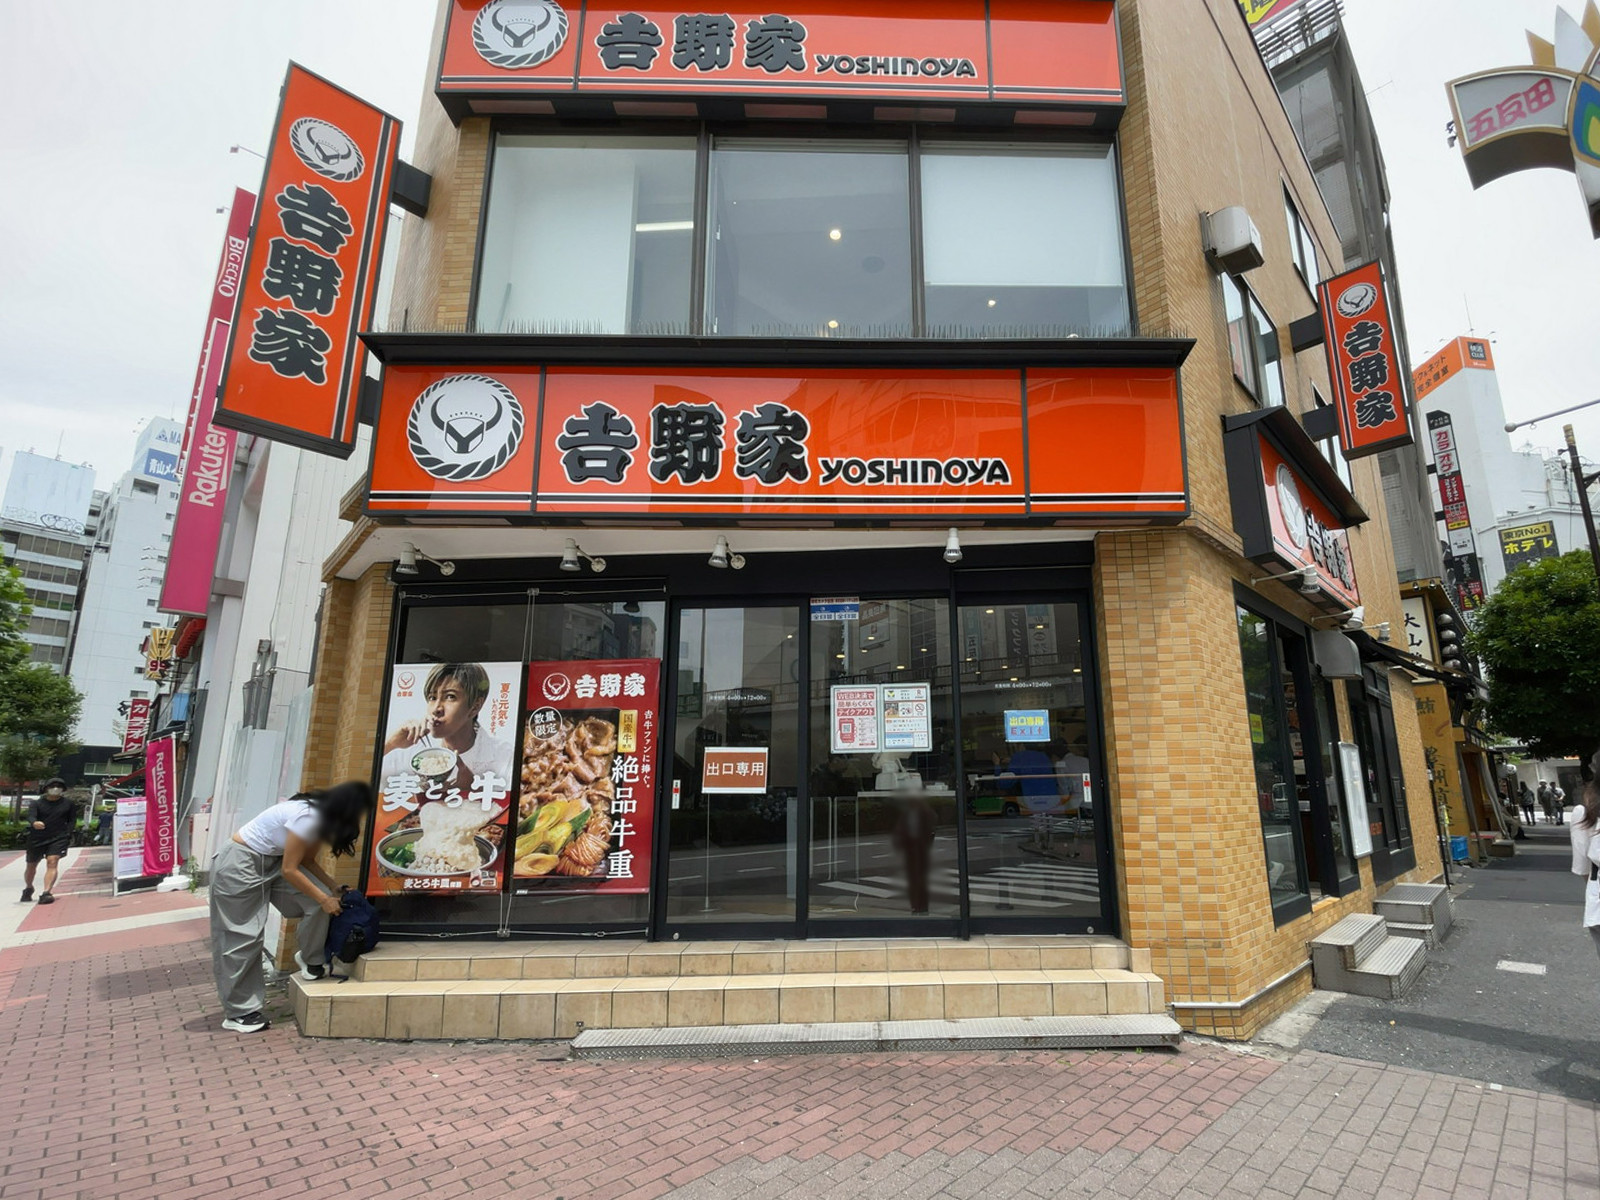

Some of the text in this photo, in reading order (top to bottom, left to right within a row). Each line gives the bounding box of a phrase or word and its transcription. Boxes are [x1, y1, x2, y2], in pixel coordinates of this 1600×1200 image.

[595, 12, 808, 74] 吉野家
[814, 54, 978, 78] YOSHINOYA
[1467, 77, 1556, 143] 五反田
[218, 236, 245, 298] BIG ECHO
[248, 181, 354, 385] 吉野家
[1343, 320, 1397, 429] 吉野家
[556, 400, 810, 487] 吉野家
[818, 457, 1012, 486] YOSHINOYA
[498, 683, 510, 727] 夏の元気を
[574, 672, 646, 698] 吉野家
[534, 723, 557, 737] 限定
[535, 710, 556, 724] 数量
[838, 708, 874, 716] テイクアウト
[706, 762, 765, 776] 出口専用
[156, 752, 173, 862] Rakuten Mobile
[382, 771, 507, 812] 麦とろ牛
[606, 755, 640, 879] 絶品牛重
